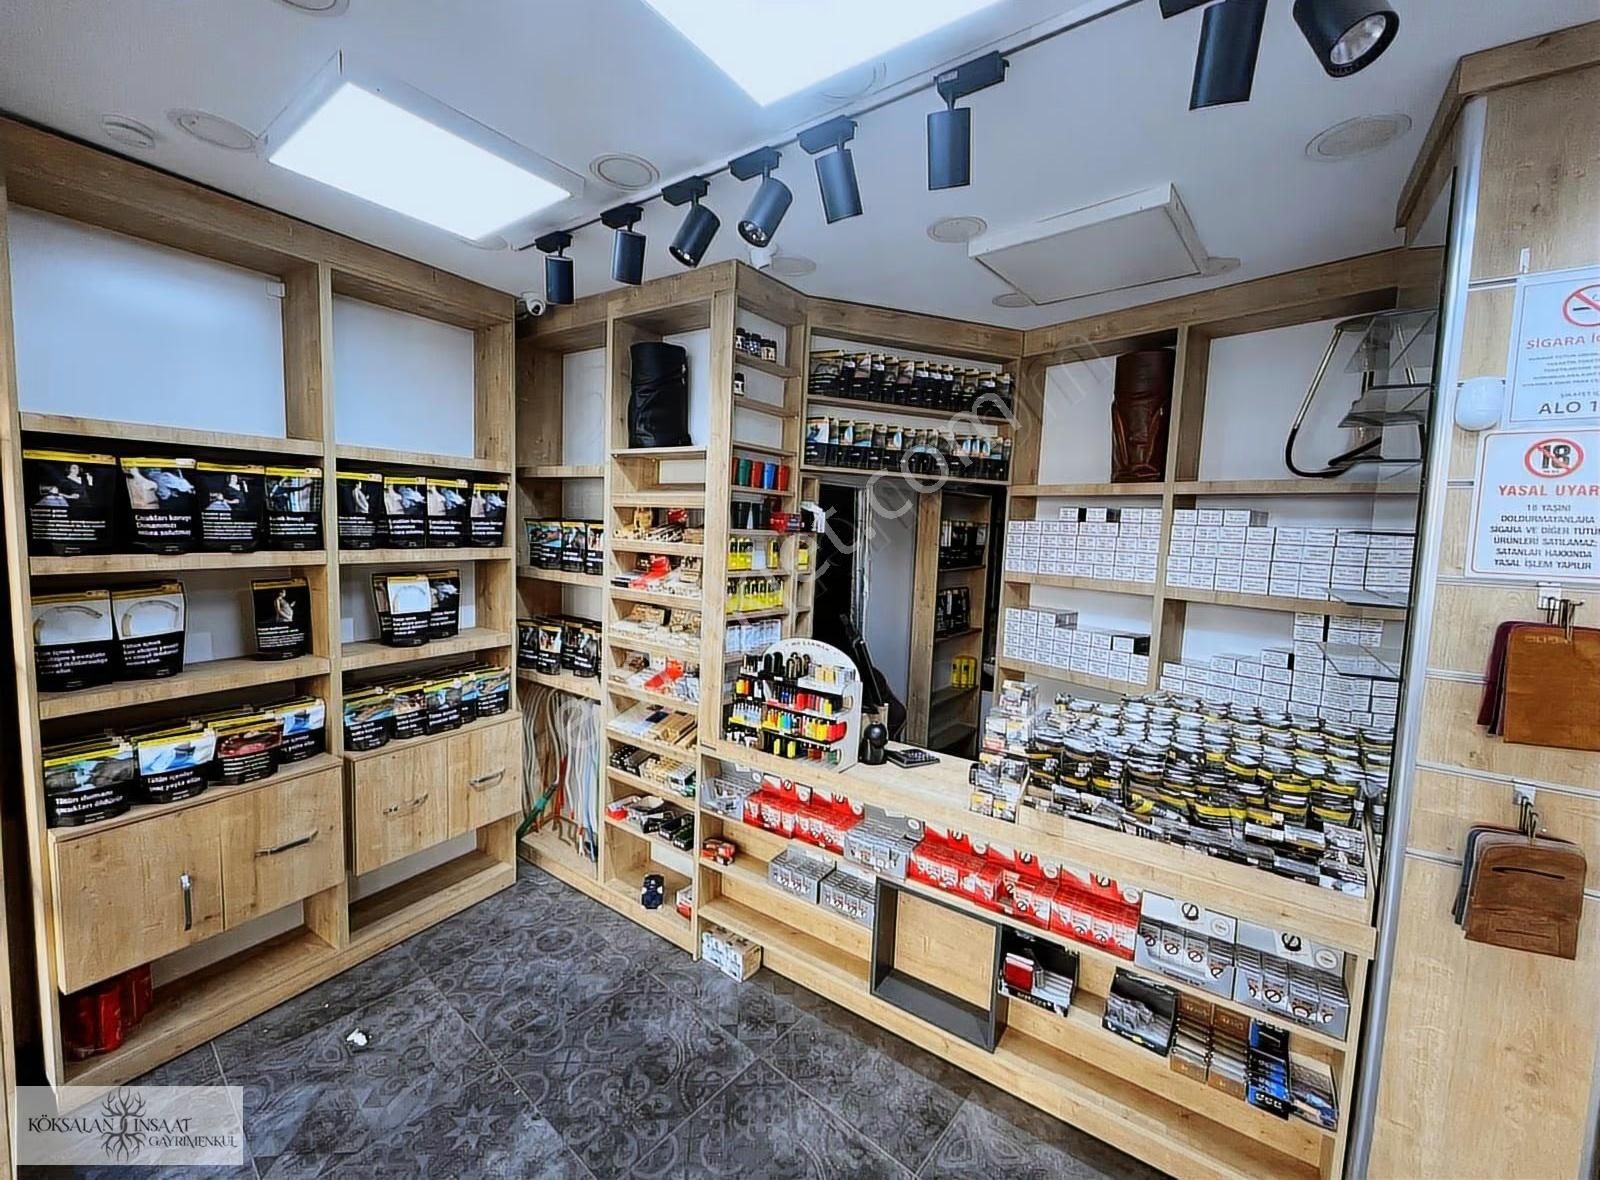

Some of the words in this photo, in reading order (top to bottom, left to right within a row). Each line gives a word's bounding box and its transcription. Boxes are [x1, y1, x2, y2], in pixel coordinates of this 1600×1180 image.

[1526, 335, 1585, 350] SİGARA
[1538, 401, 1581, 415] ALO
[1541, 444, 1571, 469] 18
[1498, 484, 1548, 497] YASAL
